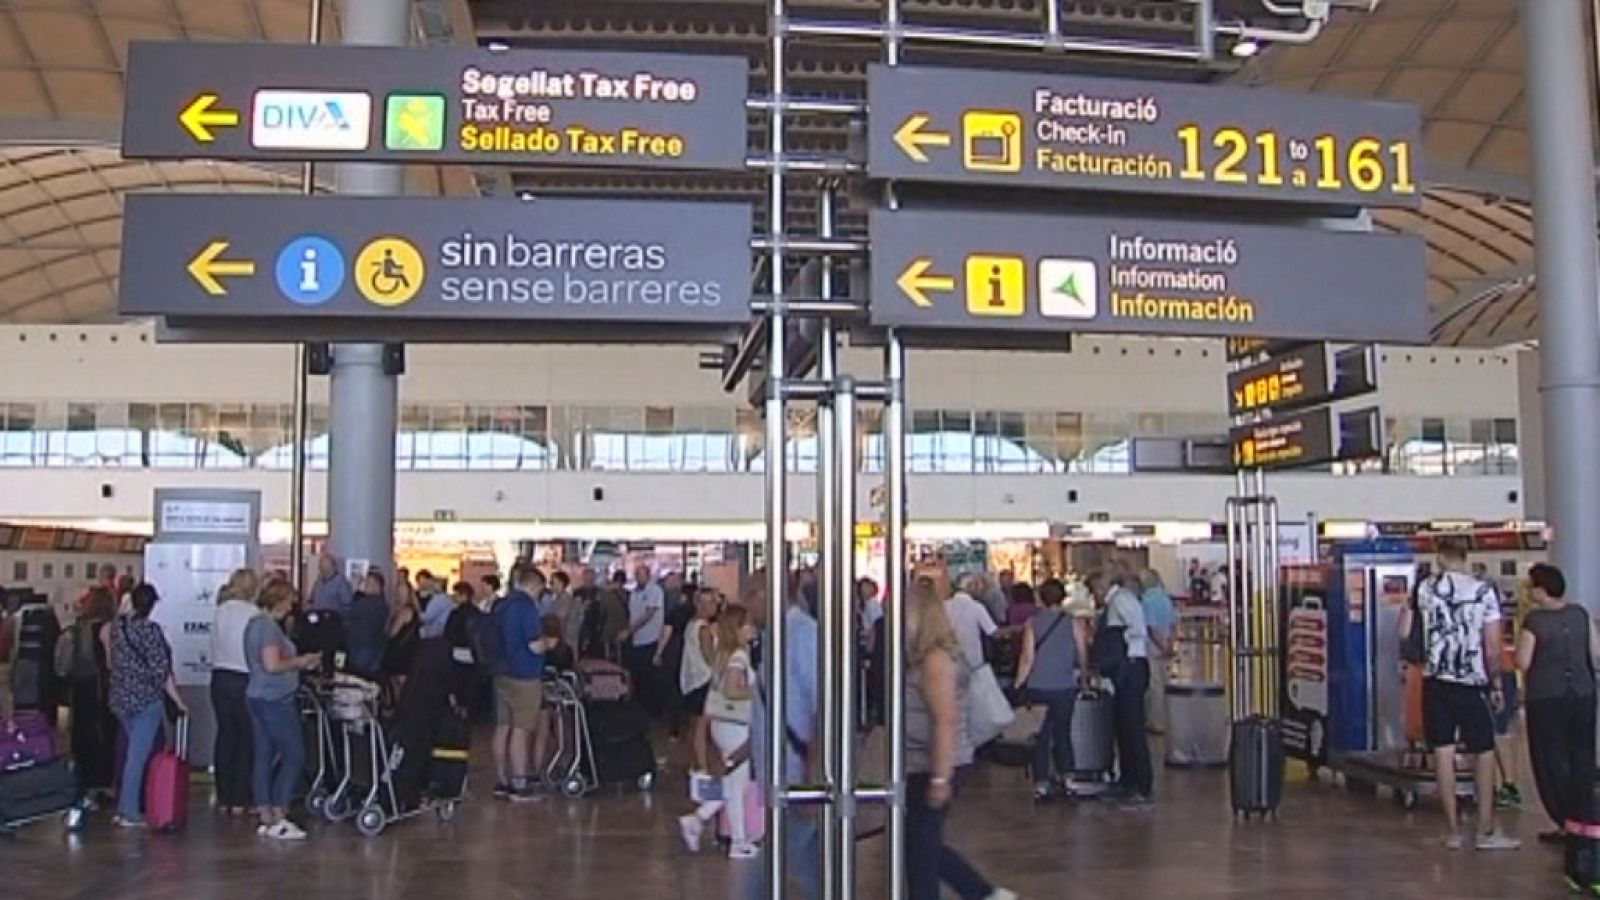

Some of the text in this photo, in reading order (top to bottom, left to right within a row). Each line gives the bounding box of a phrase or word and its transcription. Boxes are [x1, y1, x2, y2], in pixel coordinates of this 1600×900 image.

[462, 69, 697, 101] Segellat Tax Free
[462, 99, 551, 123] Tax Free
[1035, 90, 1158, 122] Facturació
[461, 125, 684, 157] Sellado Tax Free
[1036, 119, 1127, 146] Check-in
[1036, 148, 1173, 179] Facturación
[1177, 126, 1415, 193] 121 to 161
[1291, 169, 1307, 188] a
[441, 233, 666, 270] sin barreras
[1110, 234, 1238, 264] Informació
[441, 271, 722, 307] sense barreres
[1110, 264, 1226, 292] Information
[1111, 292, 1254, 323] Información
